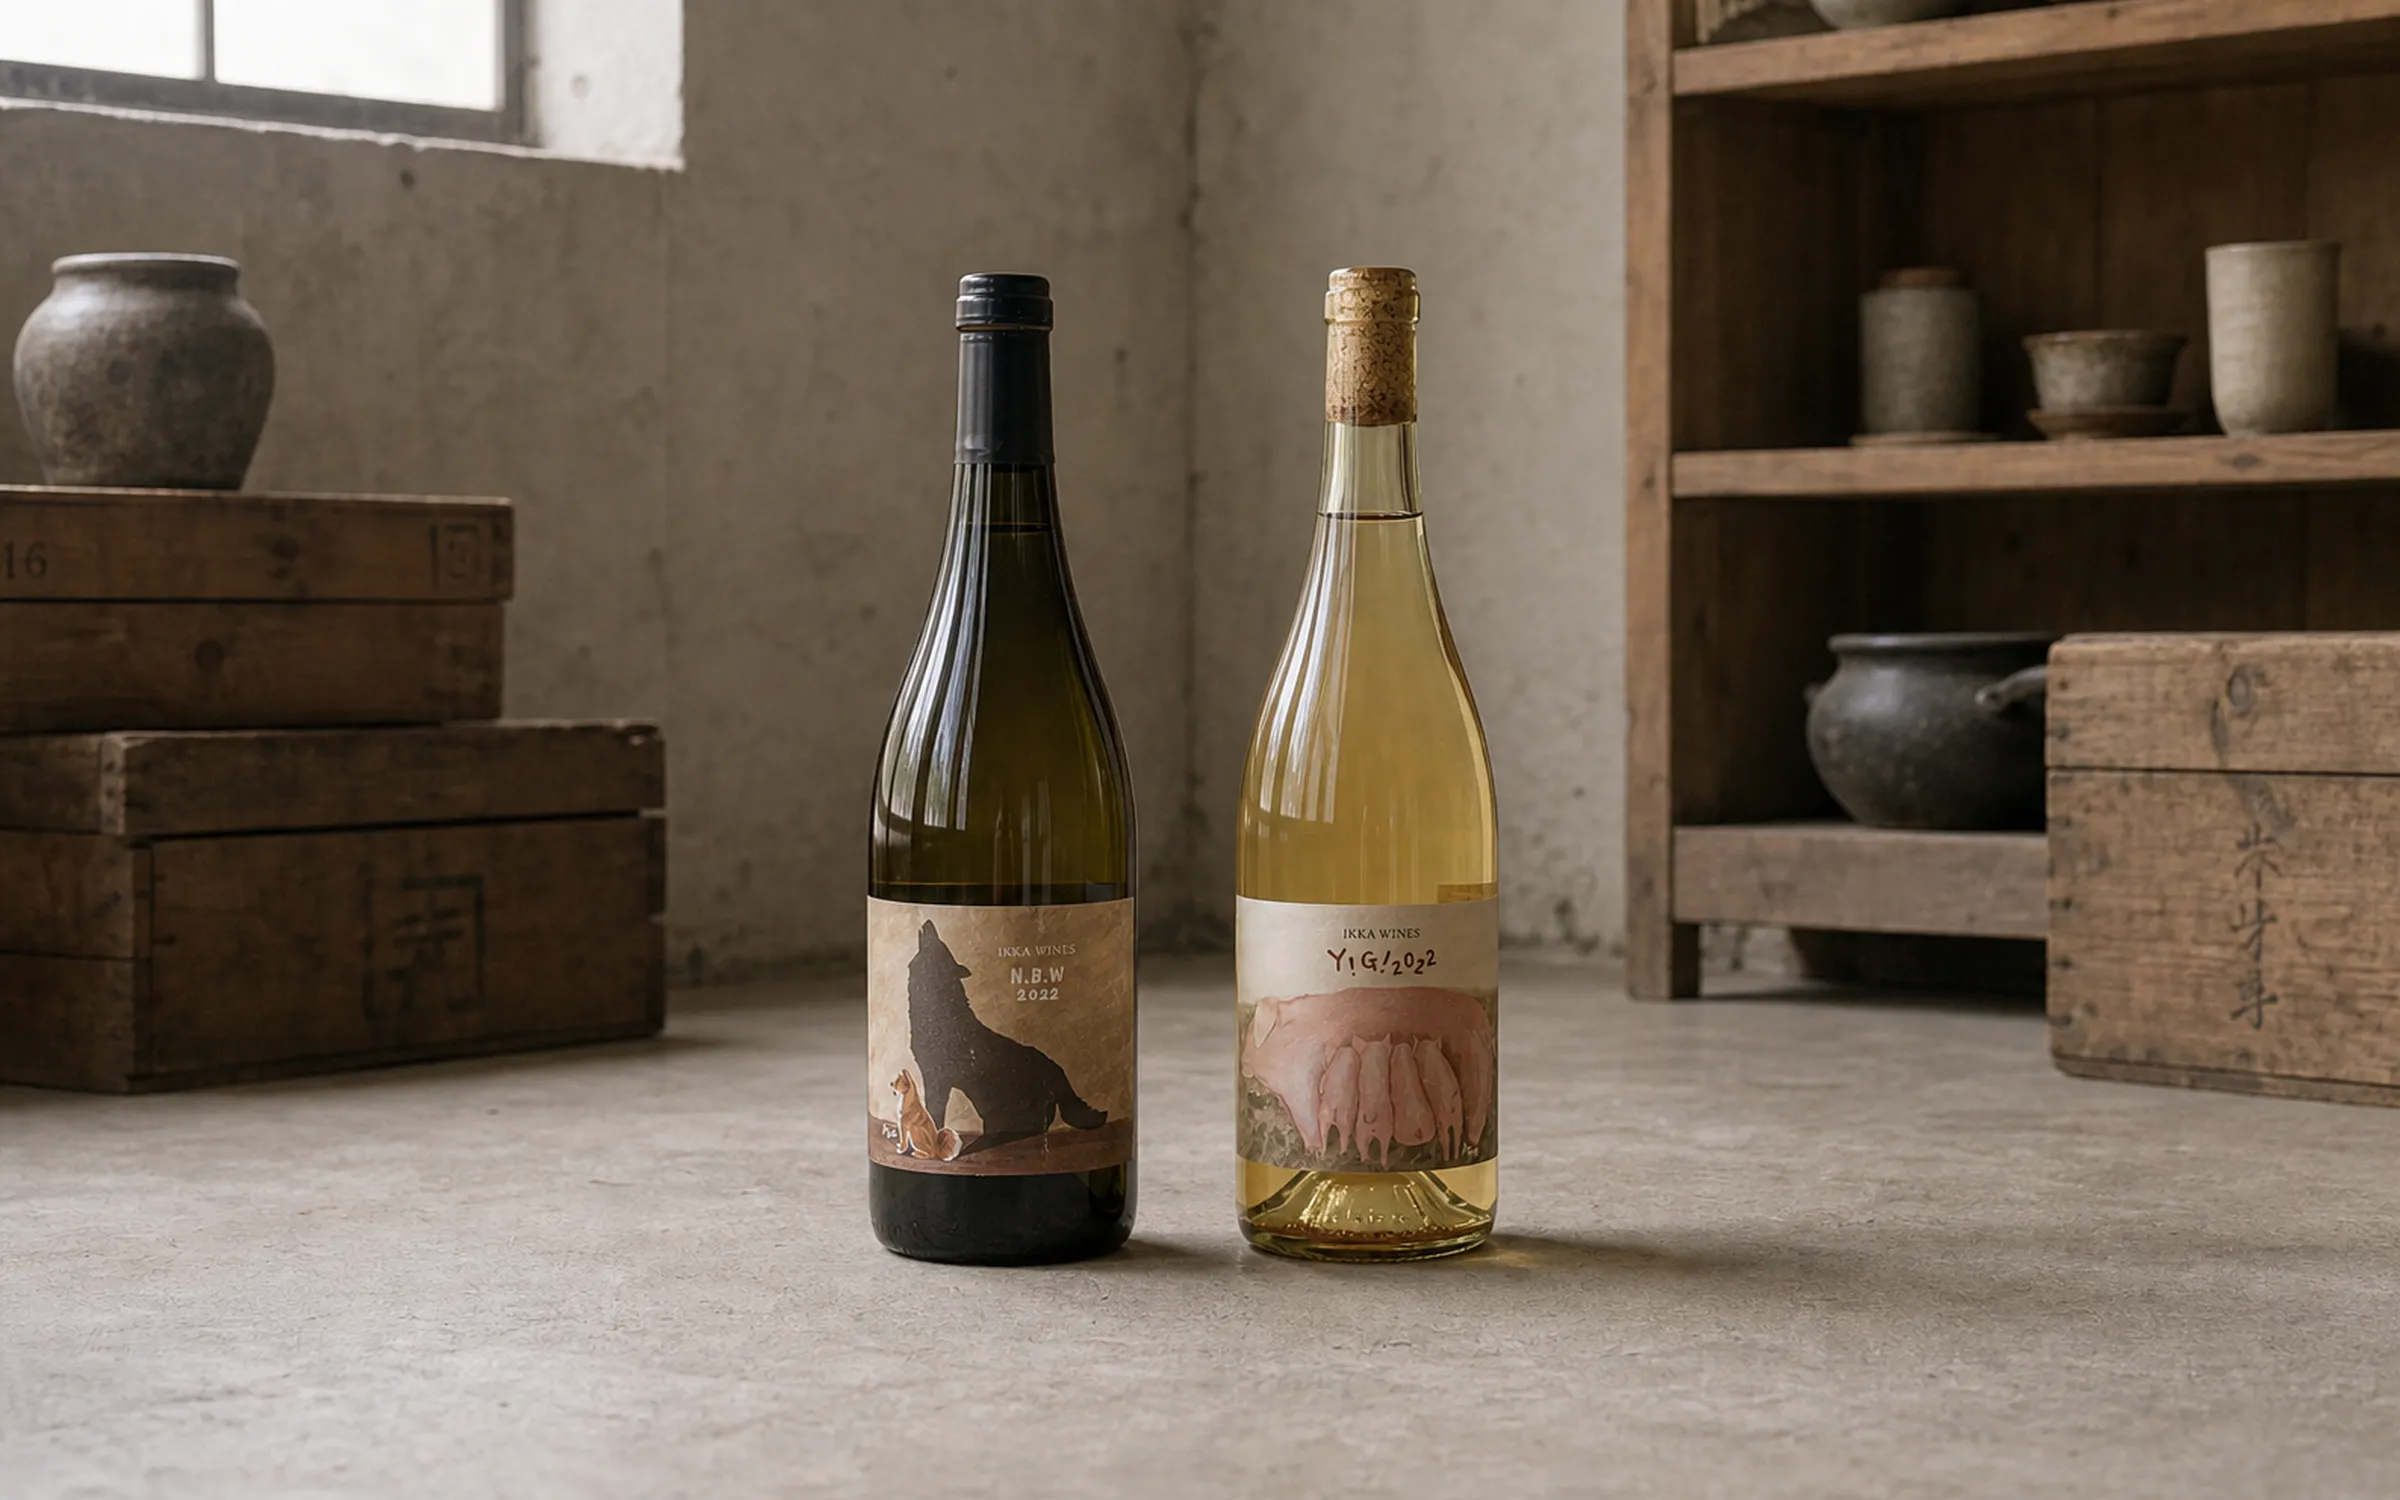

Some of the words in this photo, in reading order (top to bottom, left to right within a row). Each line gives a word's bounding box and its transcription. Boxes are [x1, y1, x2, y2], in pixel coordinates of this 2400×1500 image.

[1343, 928, 1376, 939] IKKA
[1379, 928, 1420, 939] WINES
[1035, 944, 1076, 956] WINES
[1011, 966, 1064, 985] N.B.W
[1017, 987, 1059, 1001] 2022
